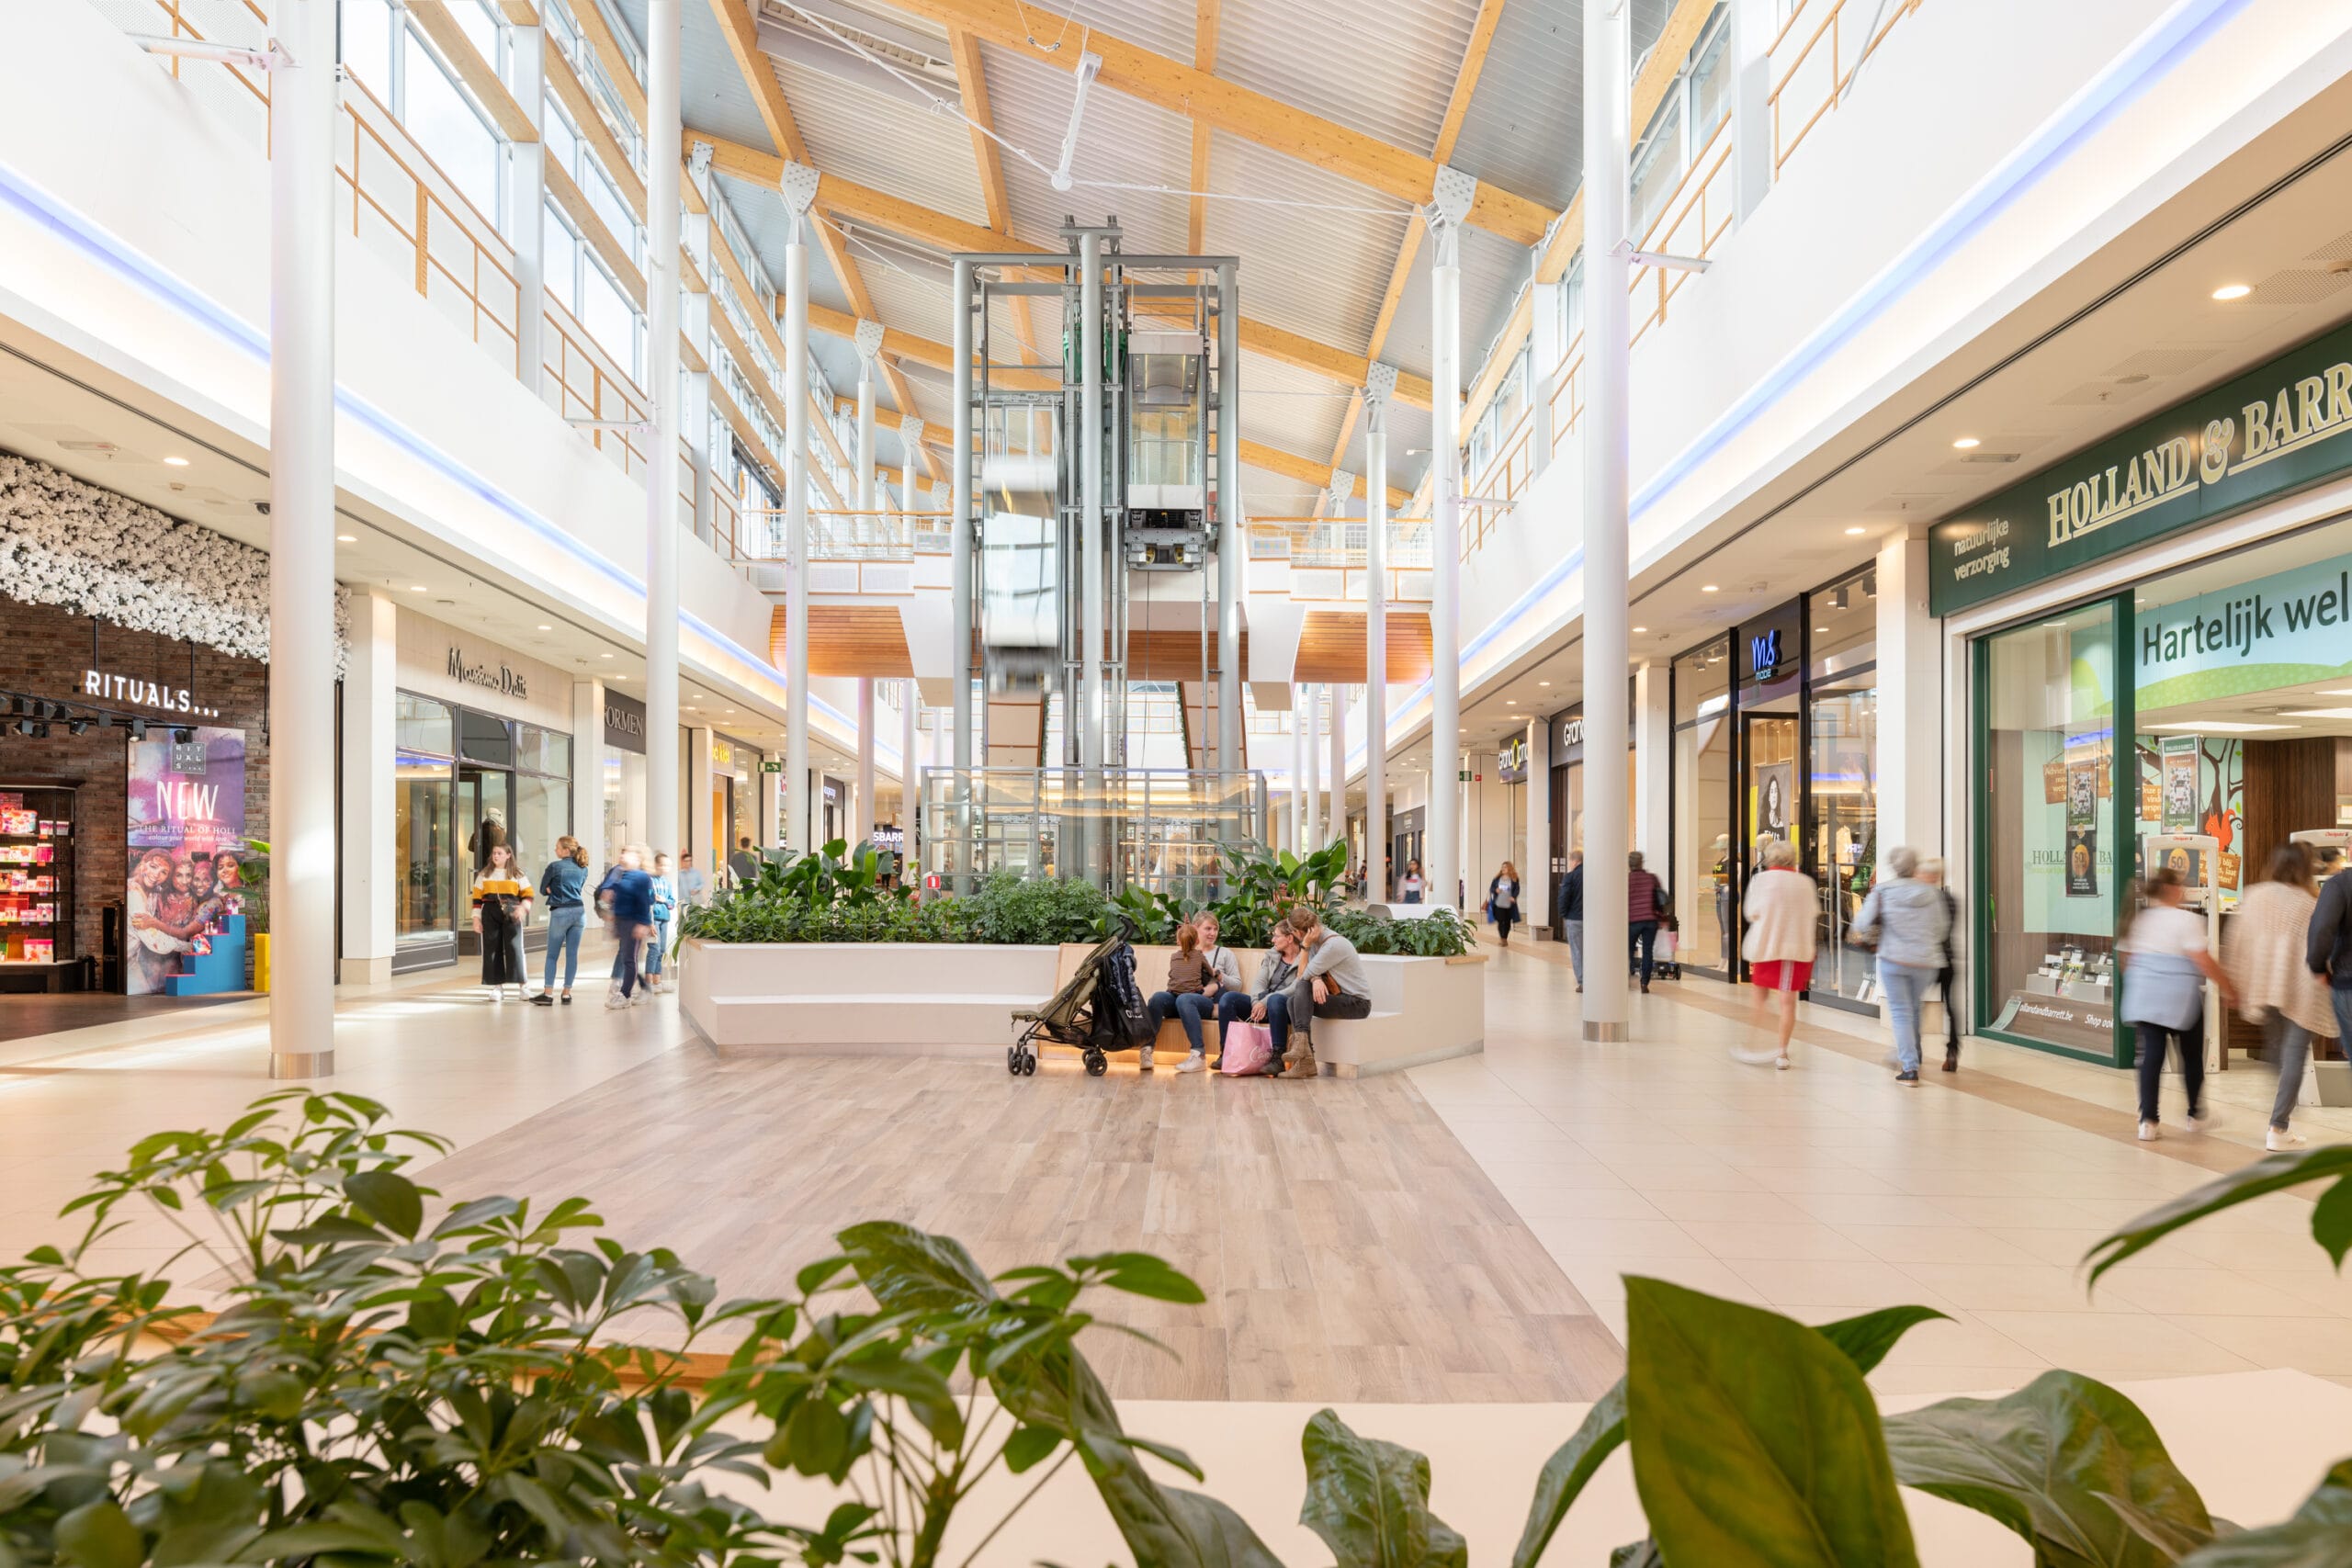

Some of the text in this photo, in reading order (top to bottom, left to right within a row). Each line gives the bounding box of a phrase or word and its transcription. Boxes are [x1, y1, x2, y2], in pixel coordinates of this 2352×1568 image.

[2047, 435, 2191, 549] HOLLAND
[2199, 416, 2235, 485] &
[1954, 518, 2009, 557] natuurlijke
[1954, 547, 2010, 581] verzorging
[2143, 570, 2349, 667] Hartelijk wel
[447, 647, 527, 700] Massimo Dutti
[156, 780, 219, 820] NEW
[2032, 851, 2065, 864] HOLL
